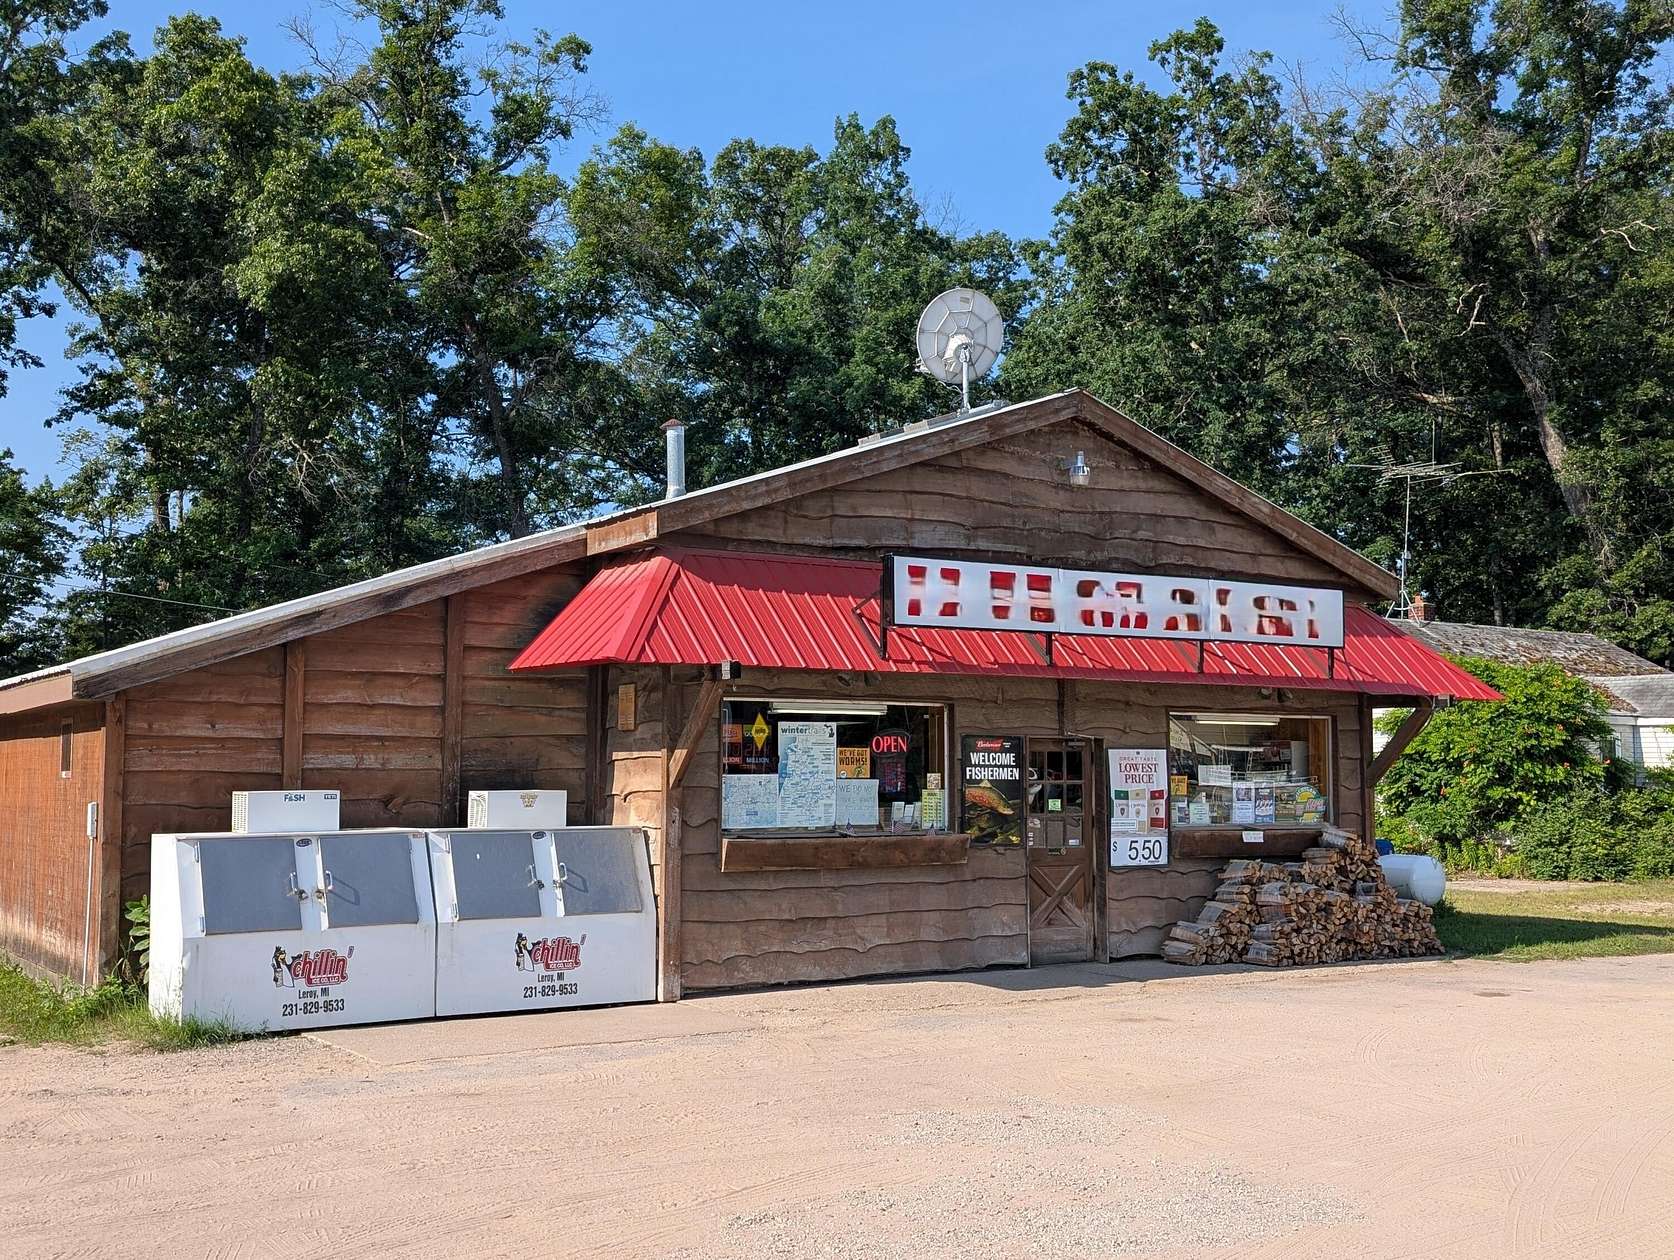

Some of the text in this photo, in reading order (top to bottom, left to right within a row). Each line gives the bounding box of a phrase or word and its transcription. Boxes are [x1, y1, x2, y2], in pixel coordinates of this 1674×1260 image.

[872, 735, 907, 753] OPEN
[839, 749, 867, 757] WE'VE GOT
[970, 752, 1016, 765] WELCOME
[839, 757, 868, 766] WORMS!
[966, 767, 1020, 780] FISHERMEN
[1119, 763, 1158, 773] LOWEST
[1125, 774, 1154, 784] PRICE
[1112, 840, 1162, 862] $ 5.50
[537, 972, 565, 983] Leroy, MI
[298, 987, 330, 999] Leroy, MI
[523, 983, 578, 998] 231-829-9533
[282, 998, 345, 1017] 231-829-9533
